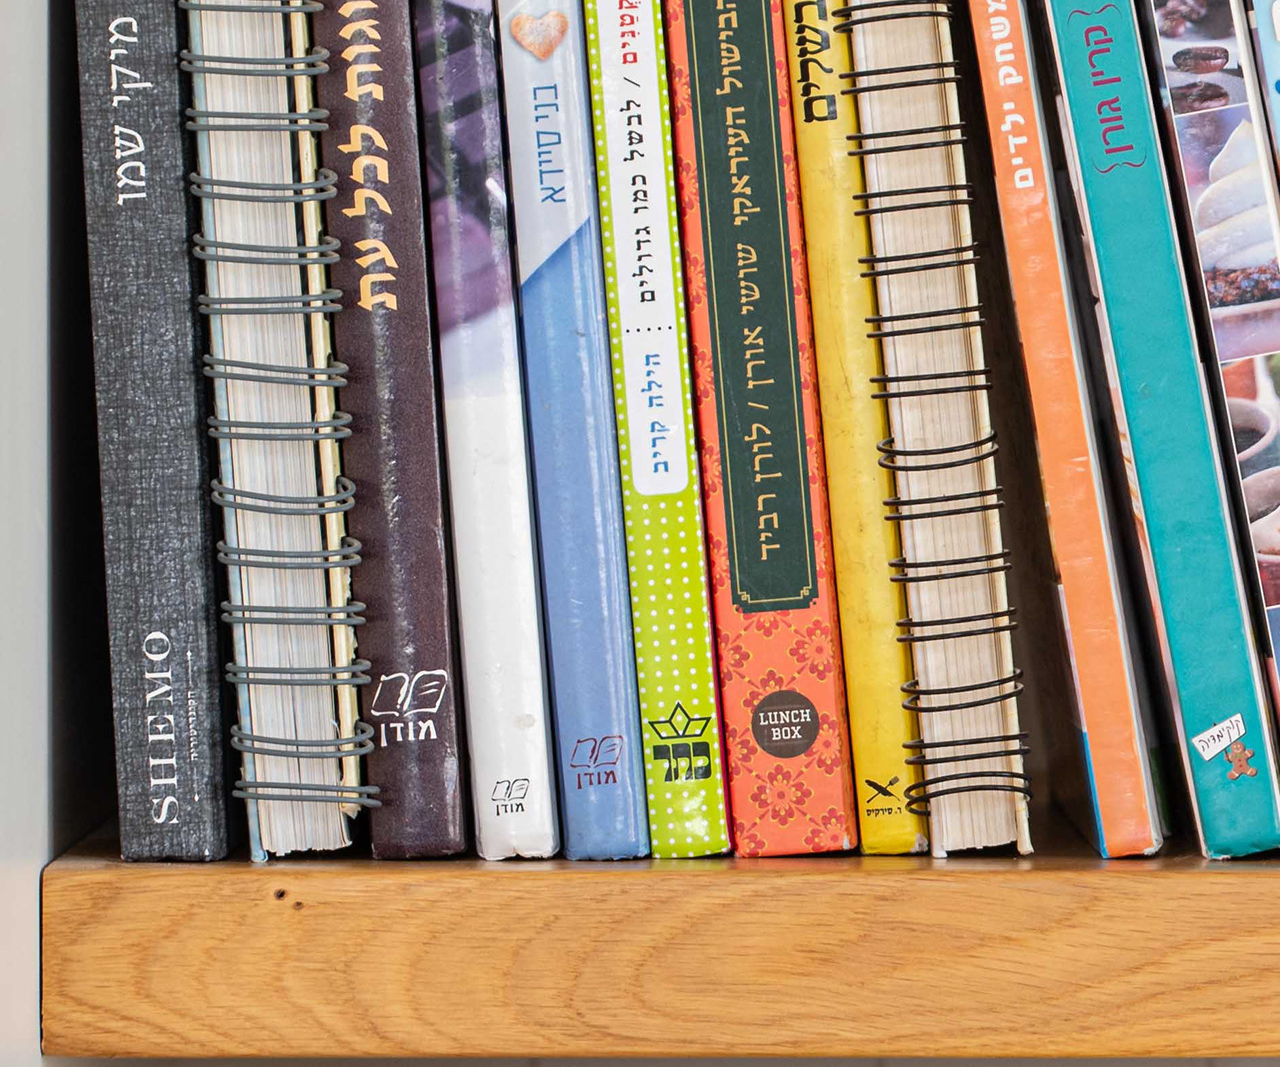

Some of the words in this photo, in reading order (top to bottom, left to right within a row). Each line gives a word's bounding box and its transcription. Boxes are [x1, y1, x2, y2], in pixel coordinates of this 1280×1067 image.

[109, 16, 153, 106] מיקי
[1084, 24, 1120, 87] קרין
[532, 83, 558, 128] בני
[620, 98, 643, 162] לבשל
[1098, 96, 1134, 155] גורן
[115, 125, 147, 206] שמו
[338, 123, 392, 218] לכל
[537, 130, 566, 204] סיידא
[725, 105, 756, 225] העיראקי
[1002, 100, 1035, 189] ילדים
[632, 172, 650, 215] כמו
[354, 239, 398, 311] עת
[633, 224, 657, 304] גדולים
[735, 243, 759, 315] שושי
[641, 352, 664, 409] הילה
[743, 327, 774, 388] אורן
[649, 420, 672, 474] קריב
[744, 423, 783, 483] לורן
[756, 491, 781, 560] רביד
[143, 631, 178, 825] SHEMO
[187, 691, 198, 761] הקונדיטוריה
[379, 721, 437, 746] מודן
[758, 709, 811, 725] LUNCH
[771, 725, 803, 740] BOX
[576, 769, 618, 789] מודן
[653, 742, 712, 782] כתר
[495, 801, 526, 815] מודן
[866, 808, 893, 818] סירקיס
